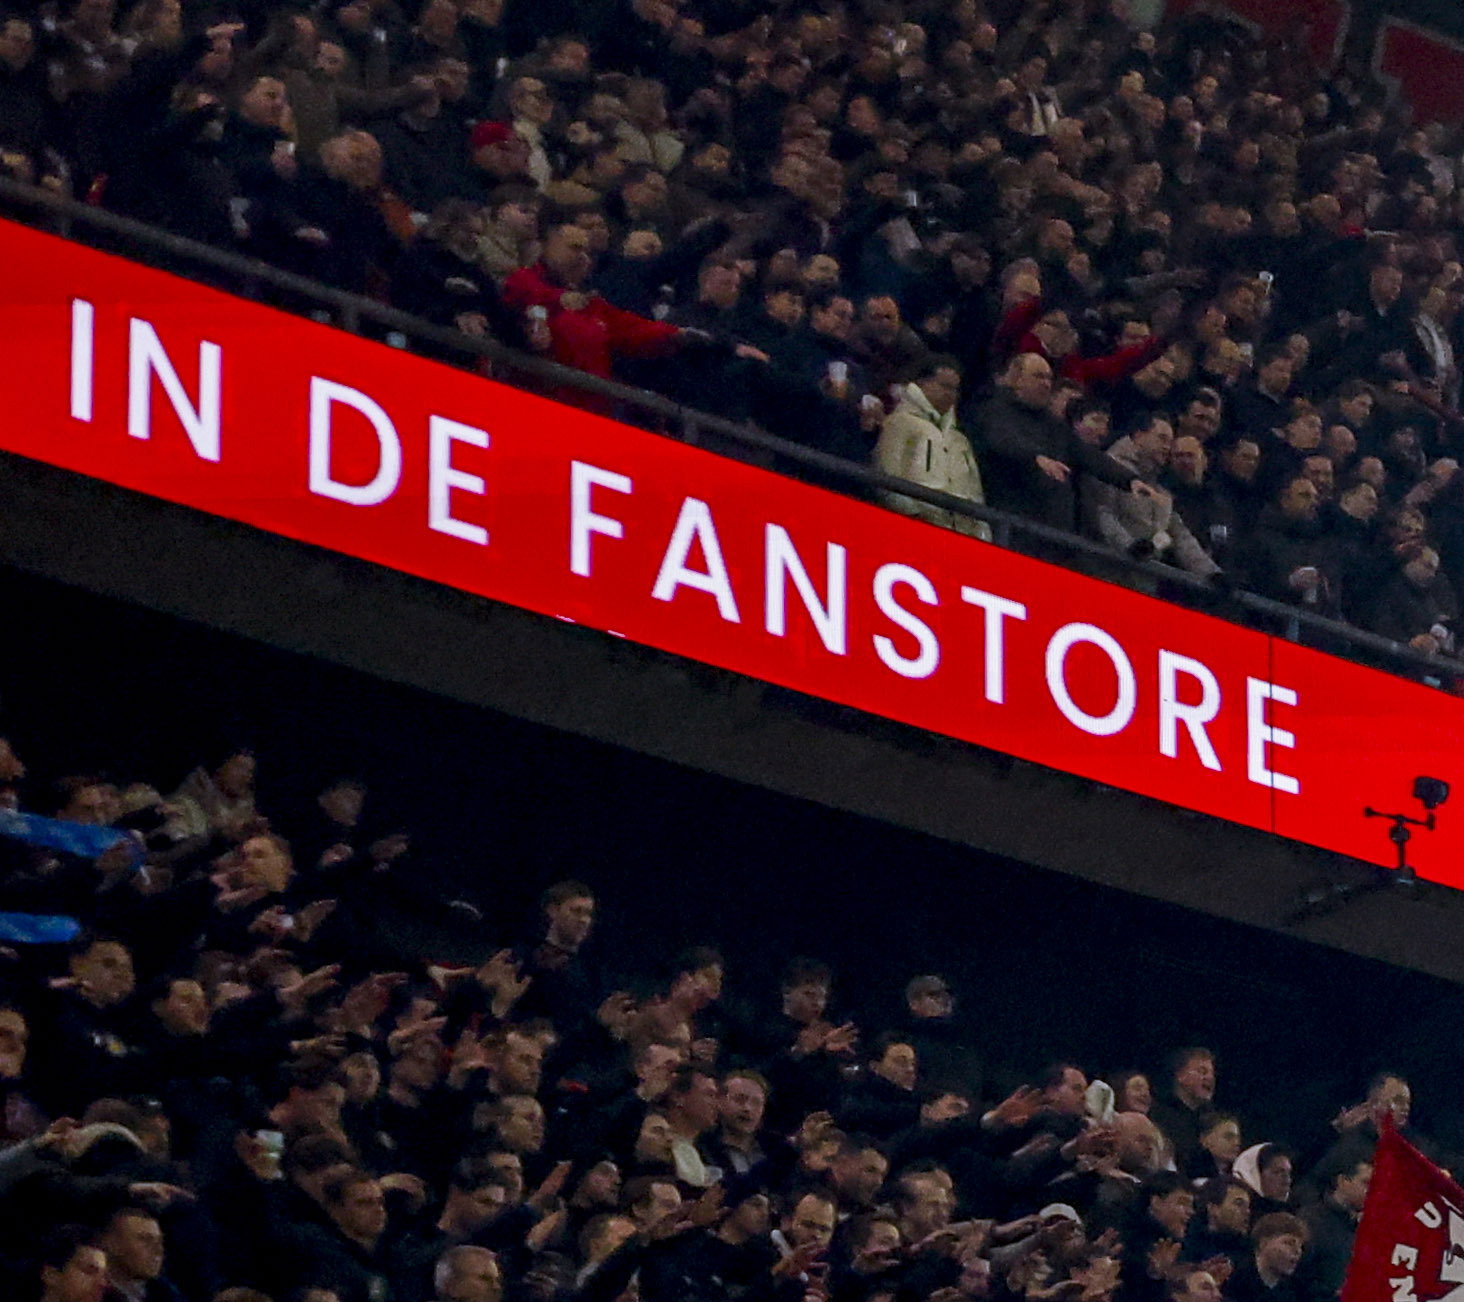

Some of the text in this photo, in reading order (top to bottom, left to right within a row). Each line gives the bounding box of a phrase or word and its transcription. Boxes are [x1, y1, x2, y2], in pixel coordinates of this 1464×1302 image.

[68, 297, 1301, 796] IN DE FANSTORE
